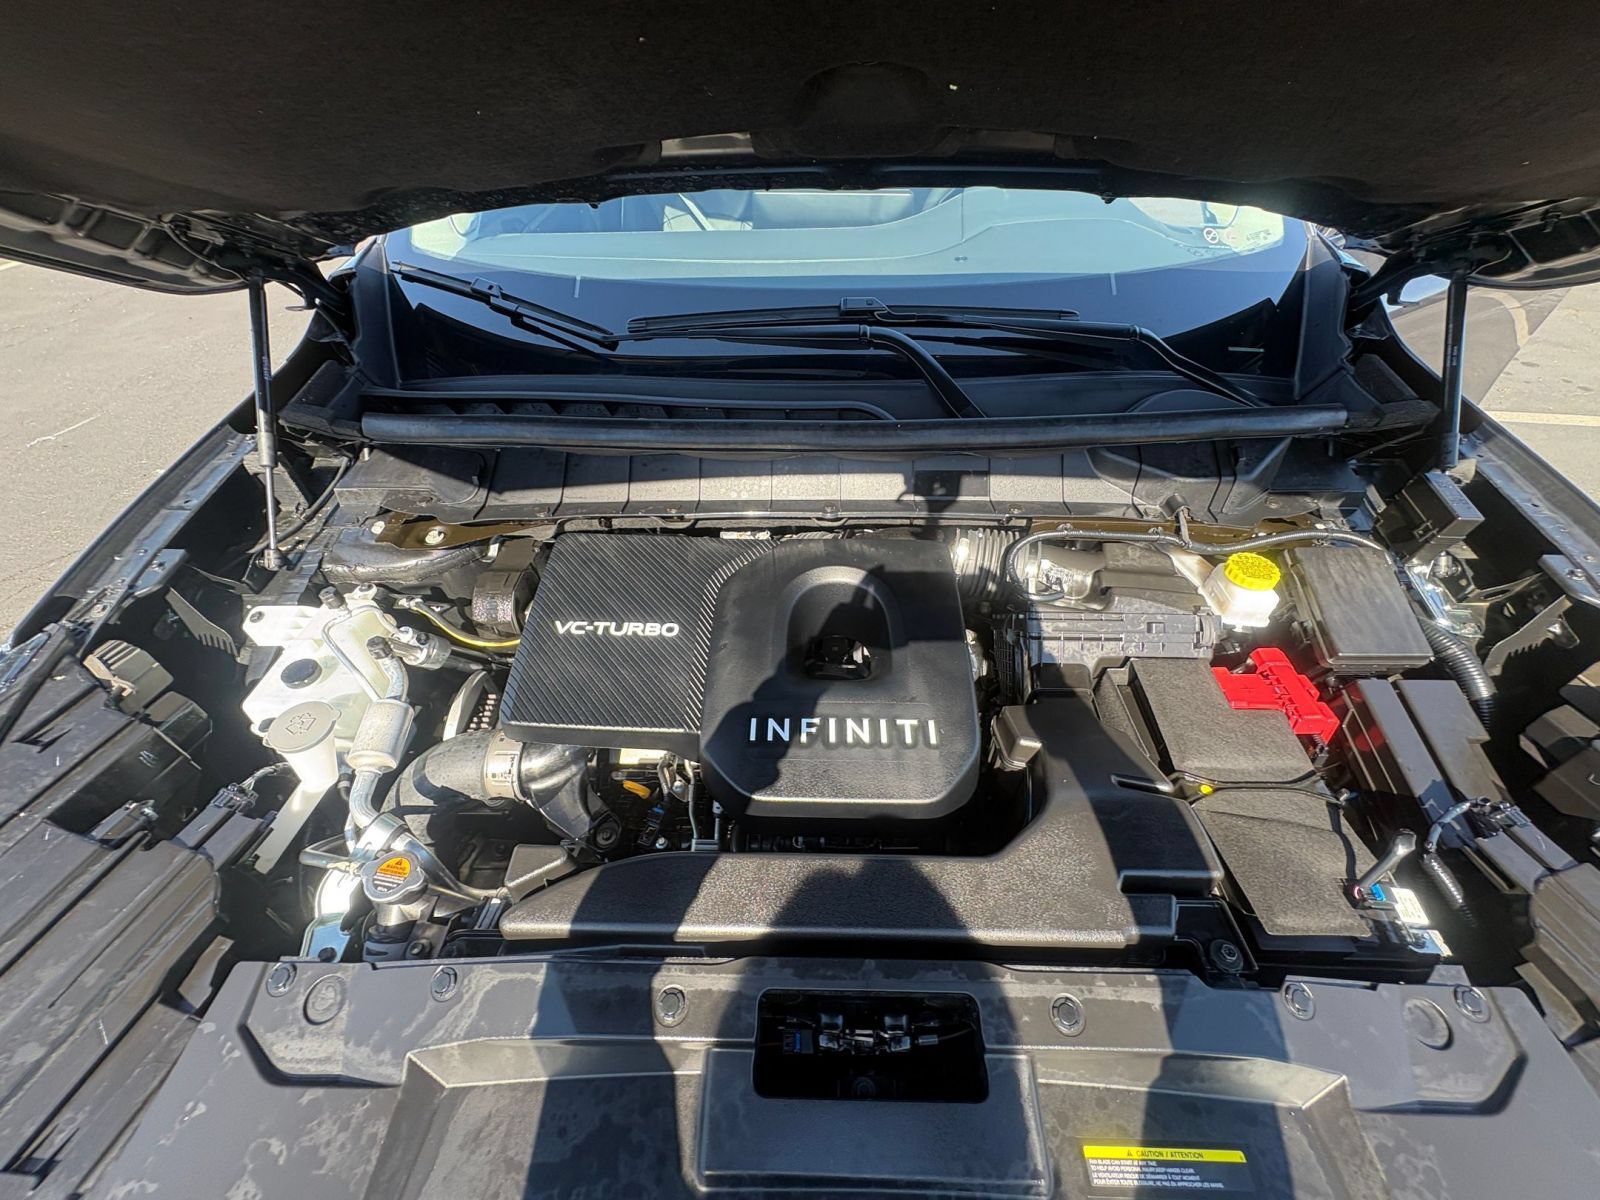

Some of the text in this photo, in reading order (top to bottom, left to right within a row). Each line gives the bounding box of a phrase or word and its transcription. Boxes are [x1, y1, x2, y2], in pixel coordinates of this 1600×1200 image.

[555, 621, 679, 637] VC-TURBO
[750, 717, 937, 745] INFINITI
[1136, 1150, 1164, 1158] CAUTION
[1170, 1151, 1204, 1159] ATTENTION
